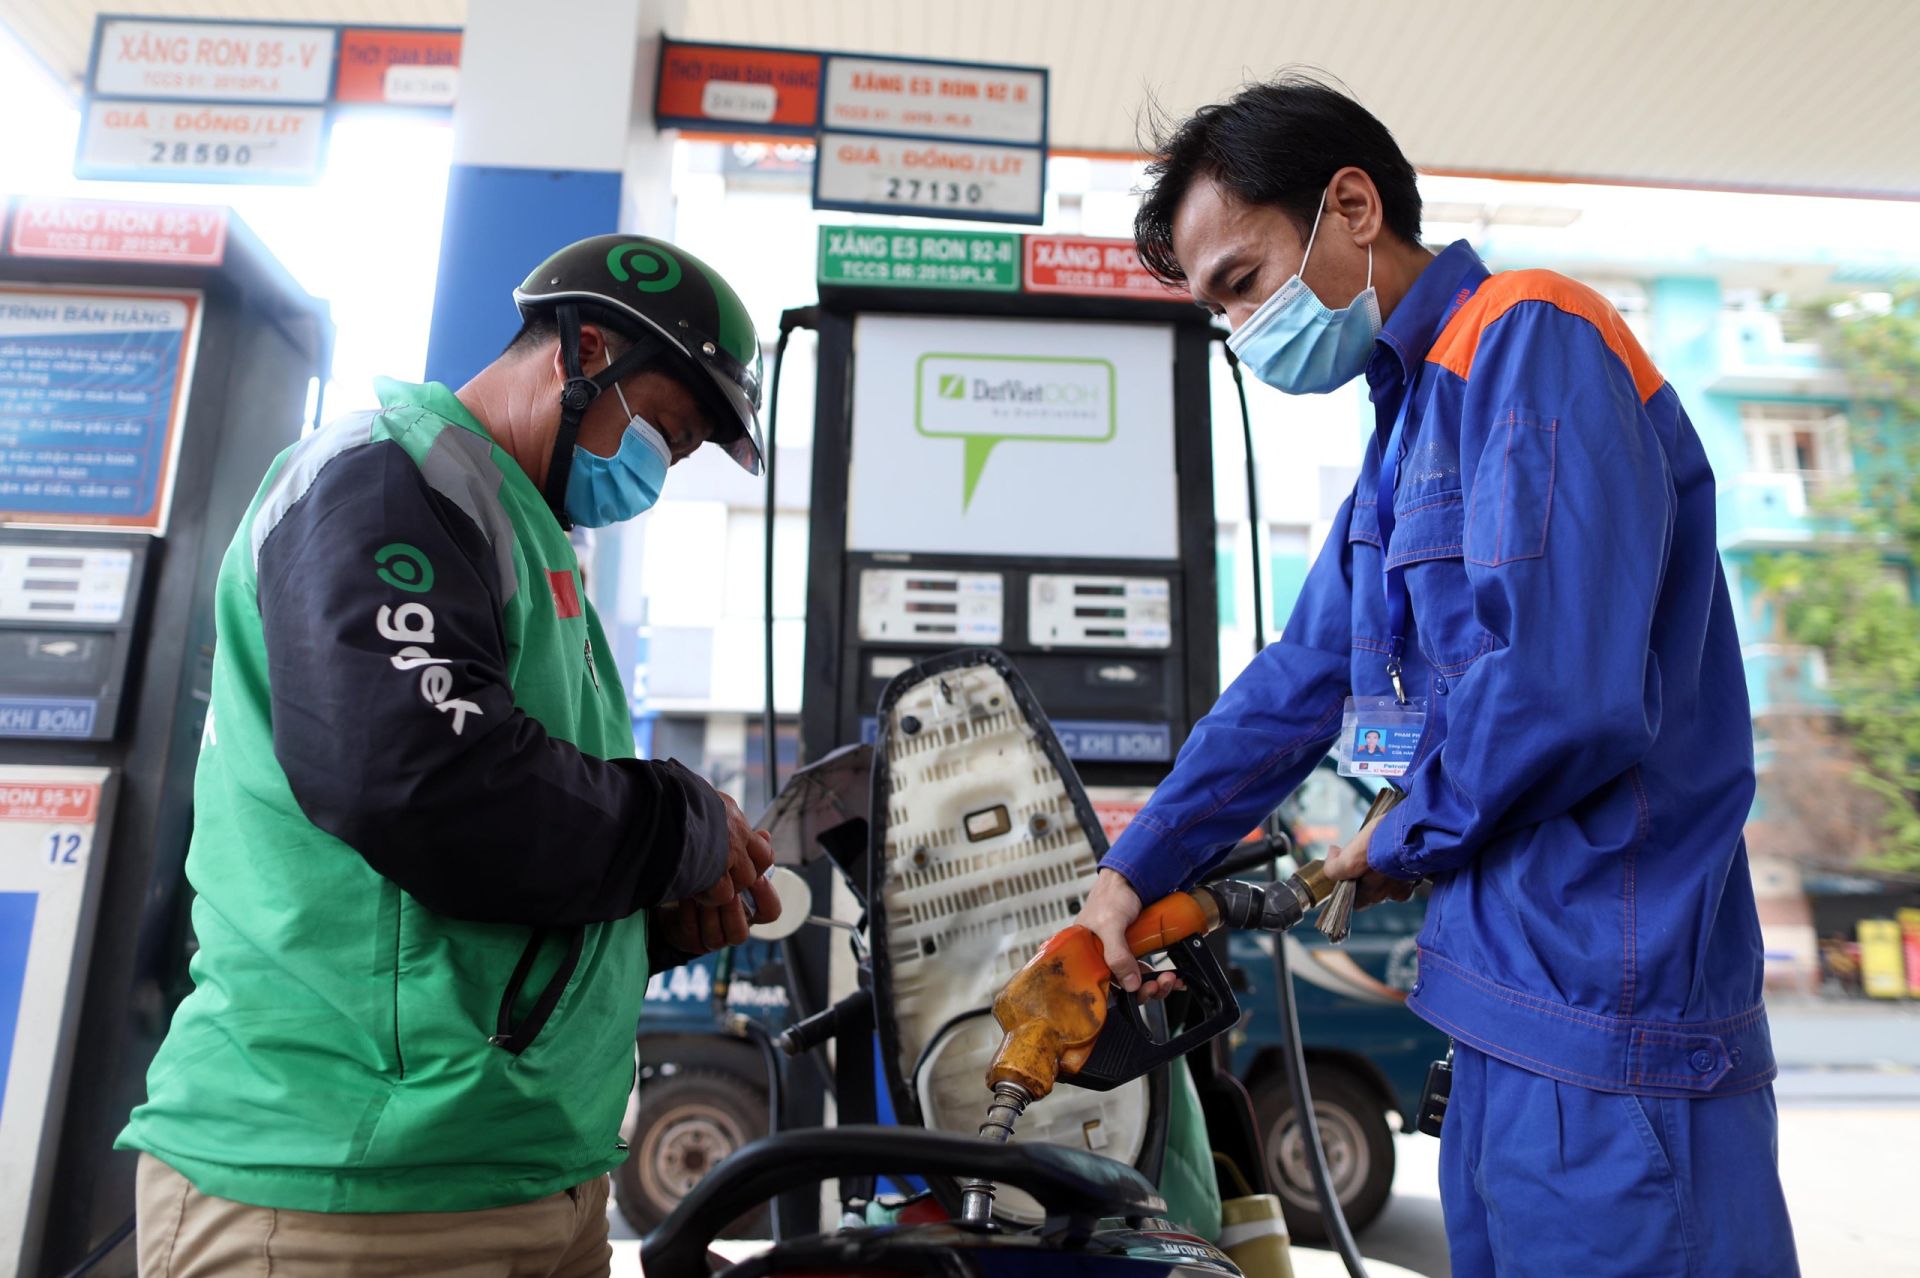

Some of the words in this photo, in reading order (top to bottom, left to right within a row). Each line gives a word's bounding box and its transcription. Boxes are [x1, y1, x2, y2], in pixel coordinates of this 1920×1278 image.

[195, 37, 249, 68] RON
[255, 40, 285, 69] 95
[299, 43, 318, 70] V
[938, 80, 980, 99] RON
[985, 83, 1008, 102] 92
[104, 108, 149, 130] GIÁ
[151, 141, 252, 165] 28590
[837, 143, 881, 165] GIÁ
[887, 178, 983, 203] 27130
[105, 207, 156, 234] RON
[891, 236, 919, 259] E5
[921, 238, 968, 261] RON
[842, 260, 890, 279] TCCS
[63, 304, 106, 324] BÁN
[112, 306, 171, 326] HÀNG
[1080, 734, 1114, 753] KHI
[48, 833, 82, 865] 12
